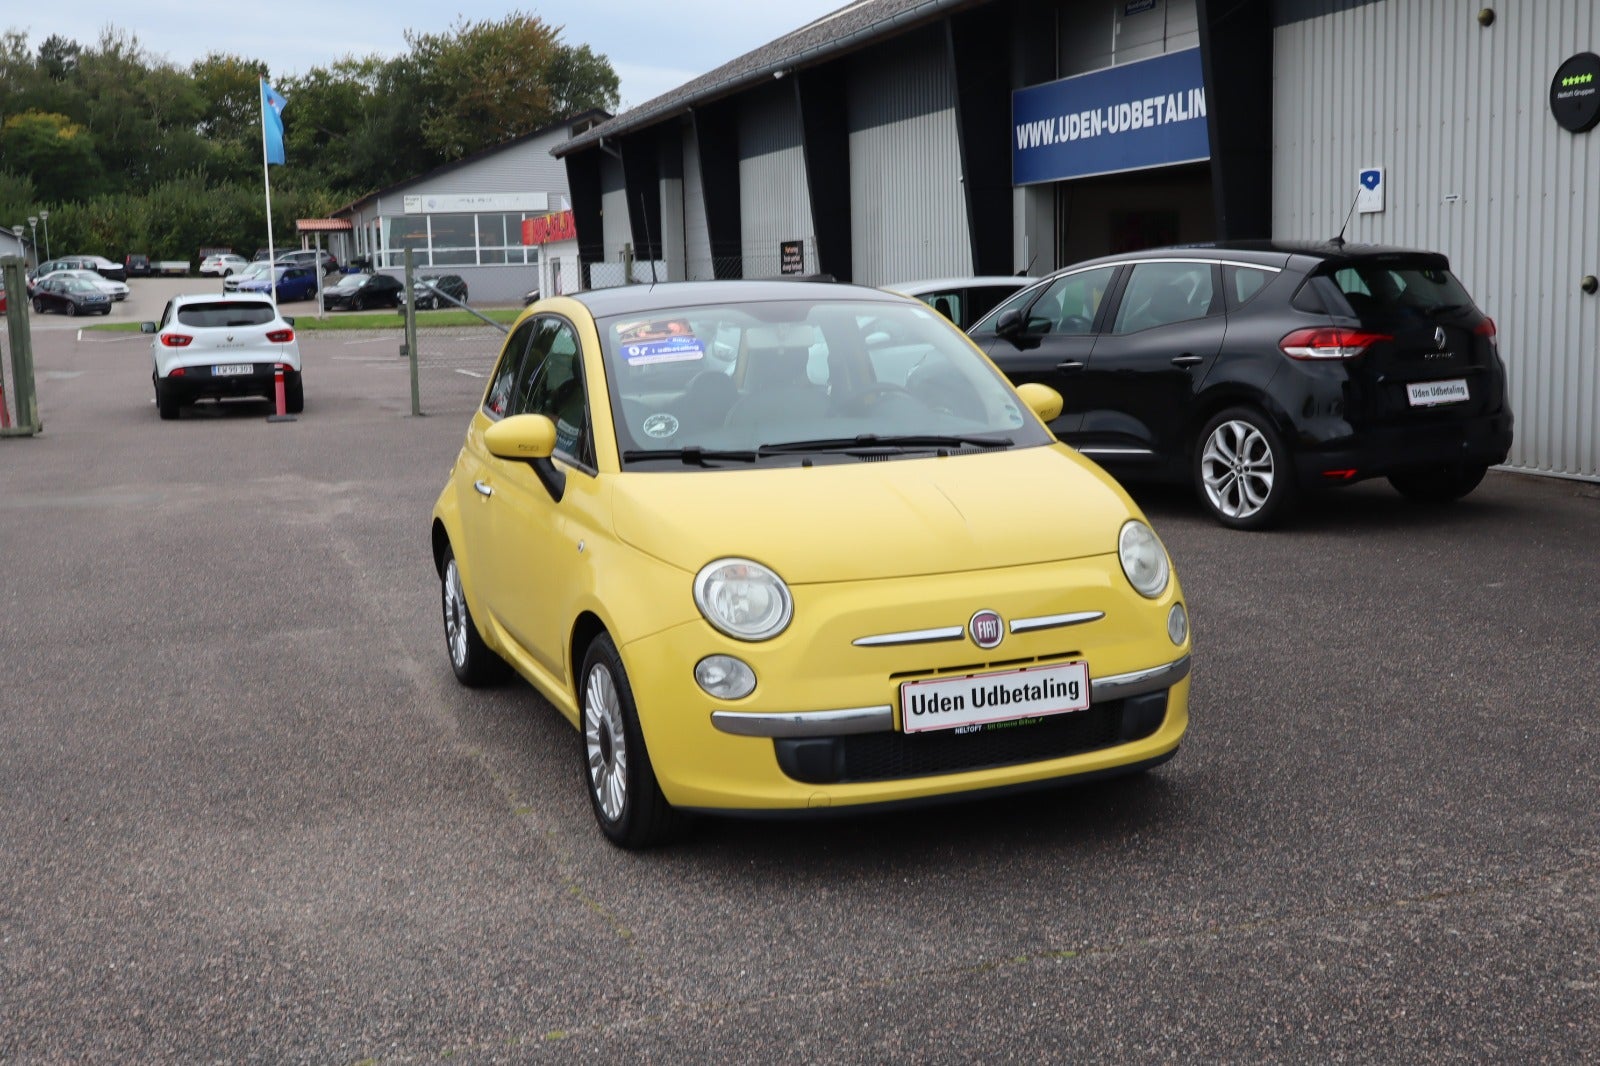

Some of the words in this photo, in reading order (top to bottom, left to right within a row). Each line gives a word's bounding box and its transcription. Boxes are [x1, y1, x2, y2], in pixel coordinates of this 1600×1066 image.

[1411, 388, 1430, 399] Uden
[1430, 384, 1465, 396] Udbetaling
[977, 620, 998, 639] FIAT
[911, 692, 965, 716] Uden
[971, 678, 1080, 708] Udbetaling
[955, 723, 982, 735] NELTOFT
